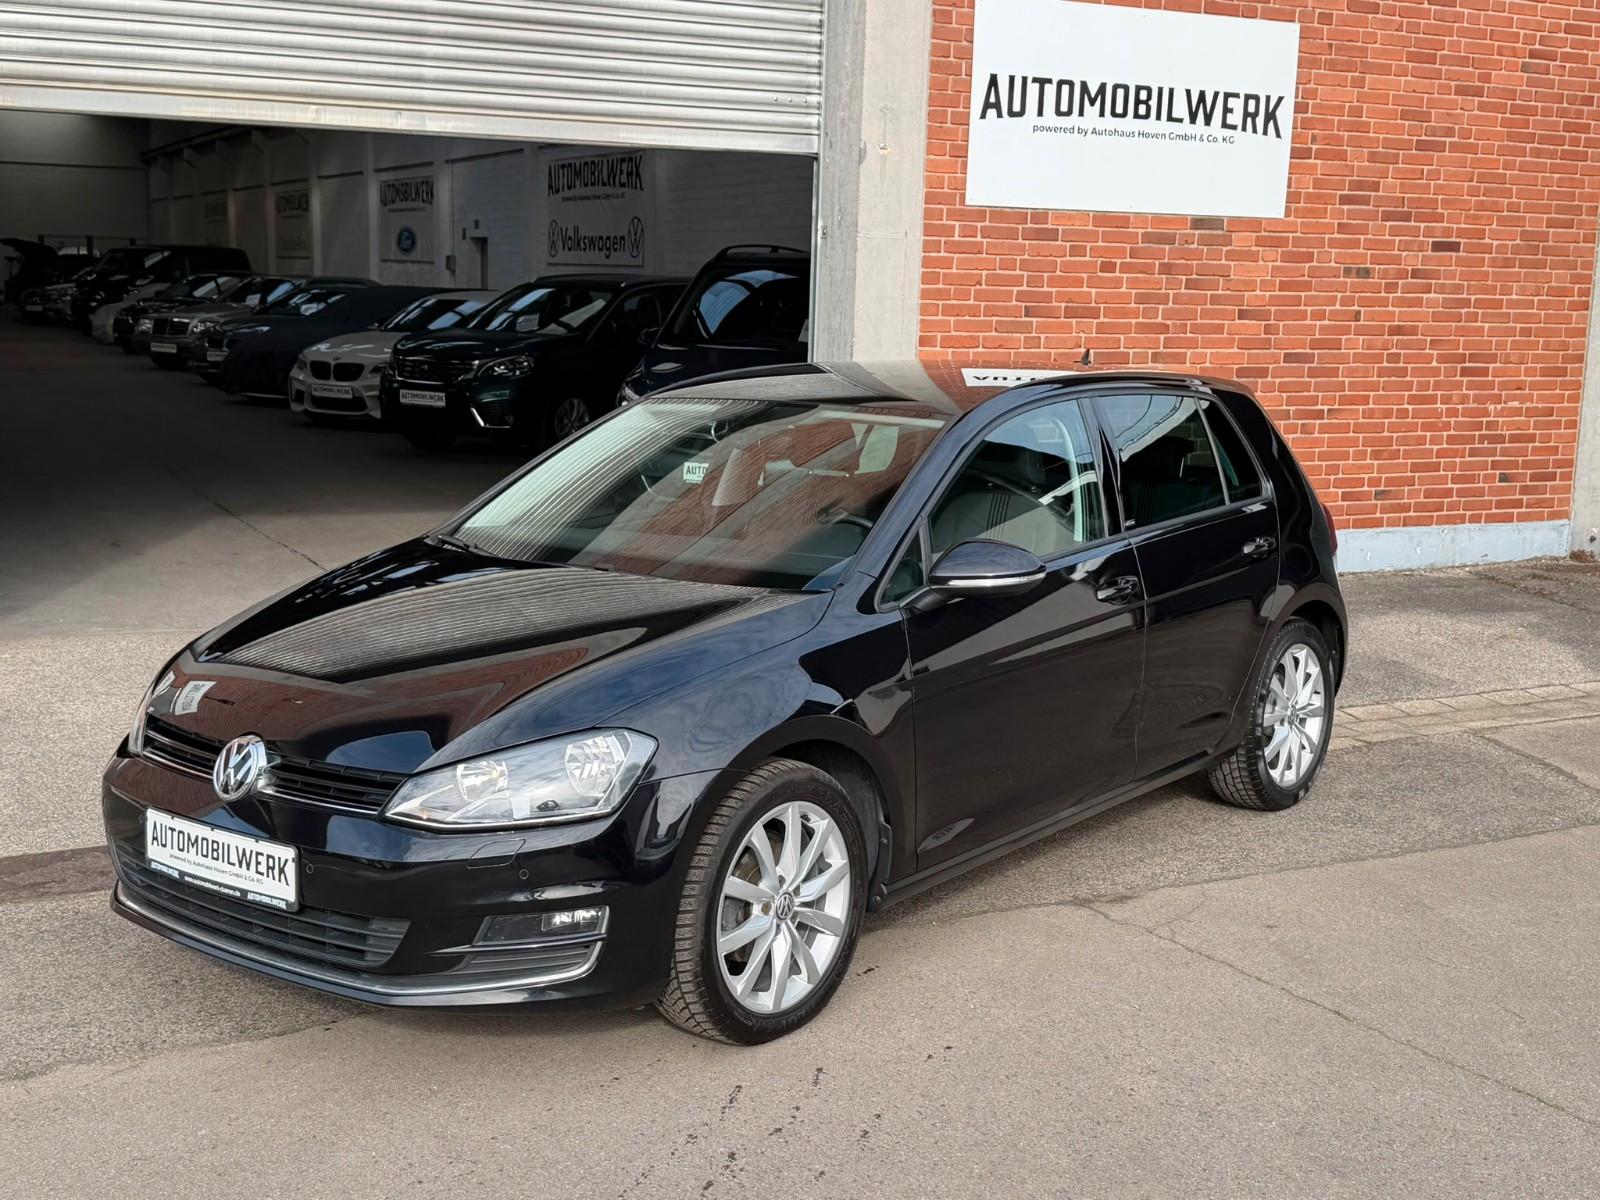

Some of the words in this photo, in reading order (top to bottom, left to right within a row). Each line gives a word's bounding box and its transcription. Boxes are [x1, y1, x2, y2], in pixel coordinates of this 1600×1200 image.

[979, 73, 1285, 139] AUTOMOBILWERK
[1033, 125, 1075, 134] powered
[1077, 126, 1089, 137] by
[1091, 127, 1135, 138] Autohaus
[1138, 130, 1166, 140] Hoven
[1168, 132, 1197, 141] GmbH
[1198, 134, 1204, 142] &
[1222, 135, 1235, 144] KG
[548, 155, 644, 197] AUTOMOBILWERK
[560, 224, 626, 259] Volkswagen
[151, 820, 290, 886] AUTOMOBILWERK
